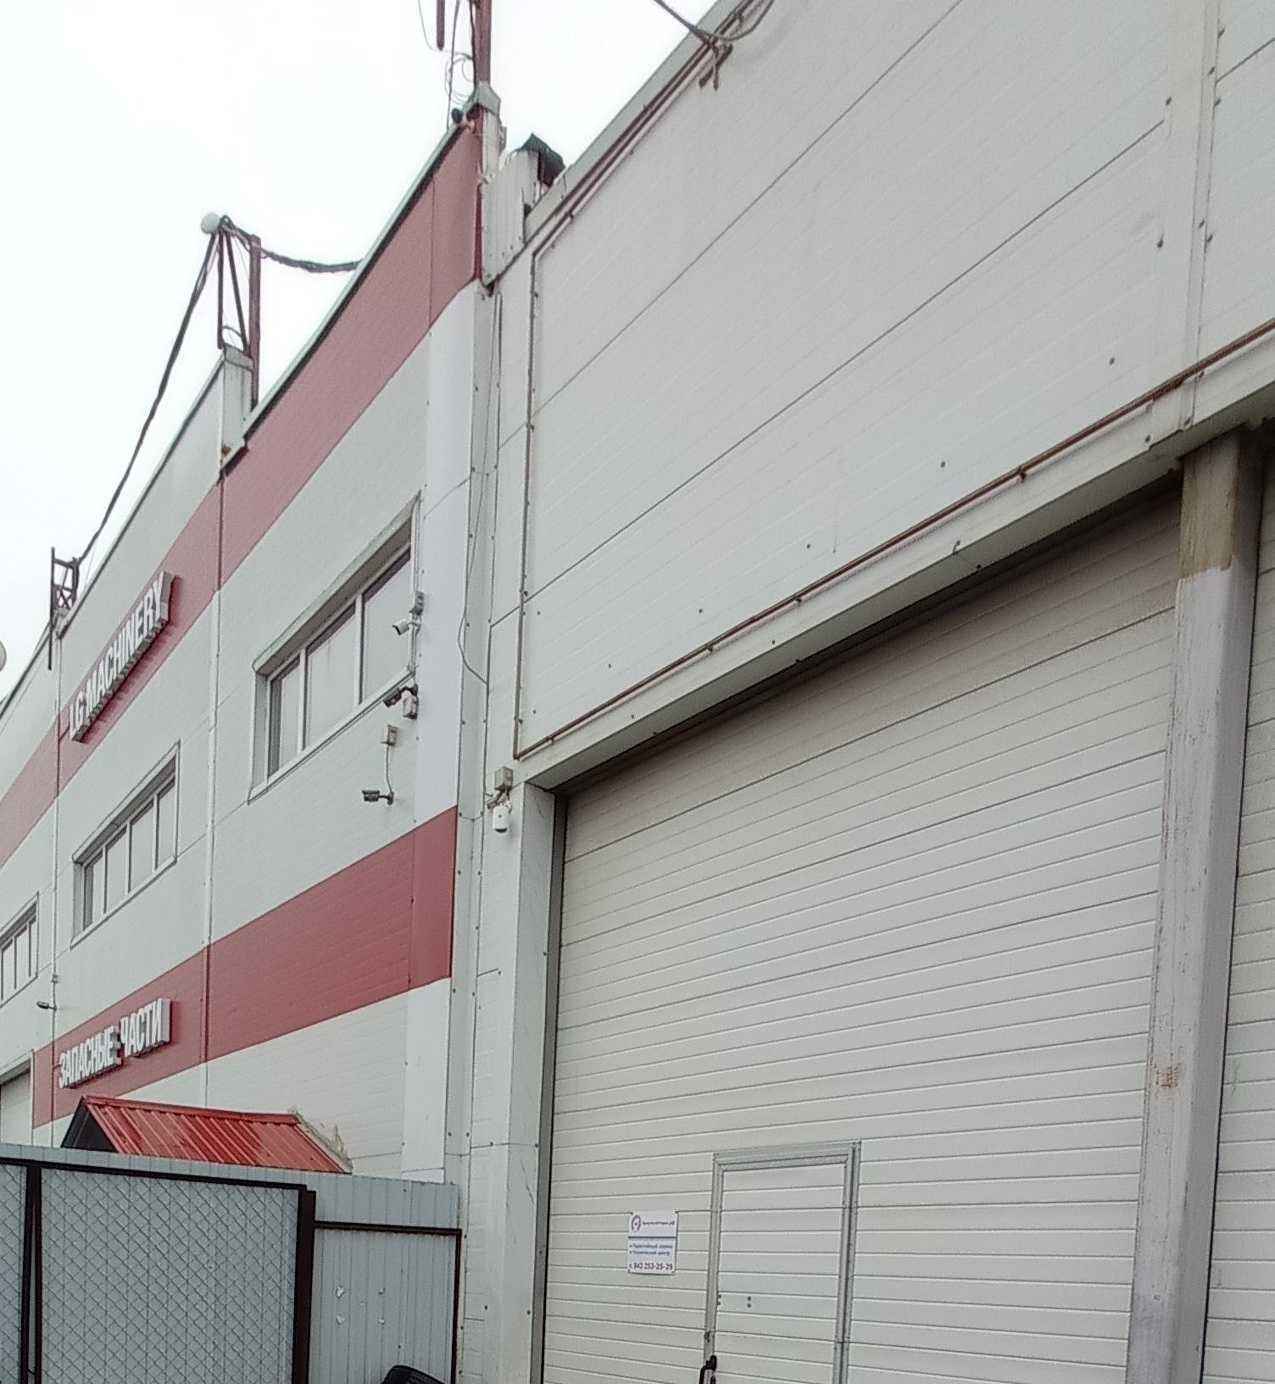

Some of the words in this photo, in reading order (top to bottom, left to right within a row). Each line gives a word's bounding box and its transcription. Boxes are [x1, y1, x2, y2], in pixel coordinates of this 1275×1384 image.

[85, 571, 168, 717] MACHINERY
[58, 1025, 119, 1089] ЗАПАСНЫЕ
[119, 998, 166, 1058] ЧАСТИ
